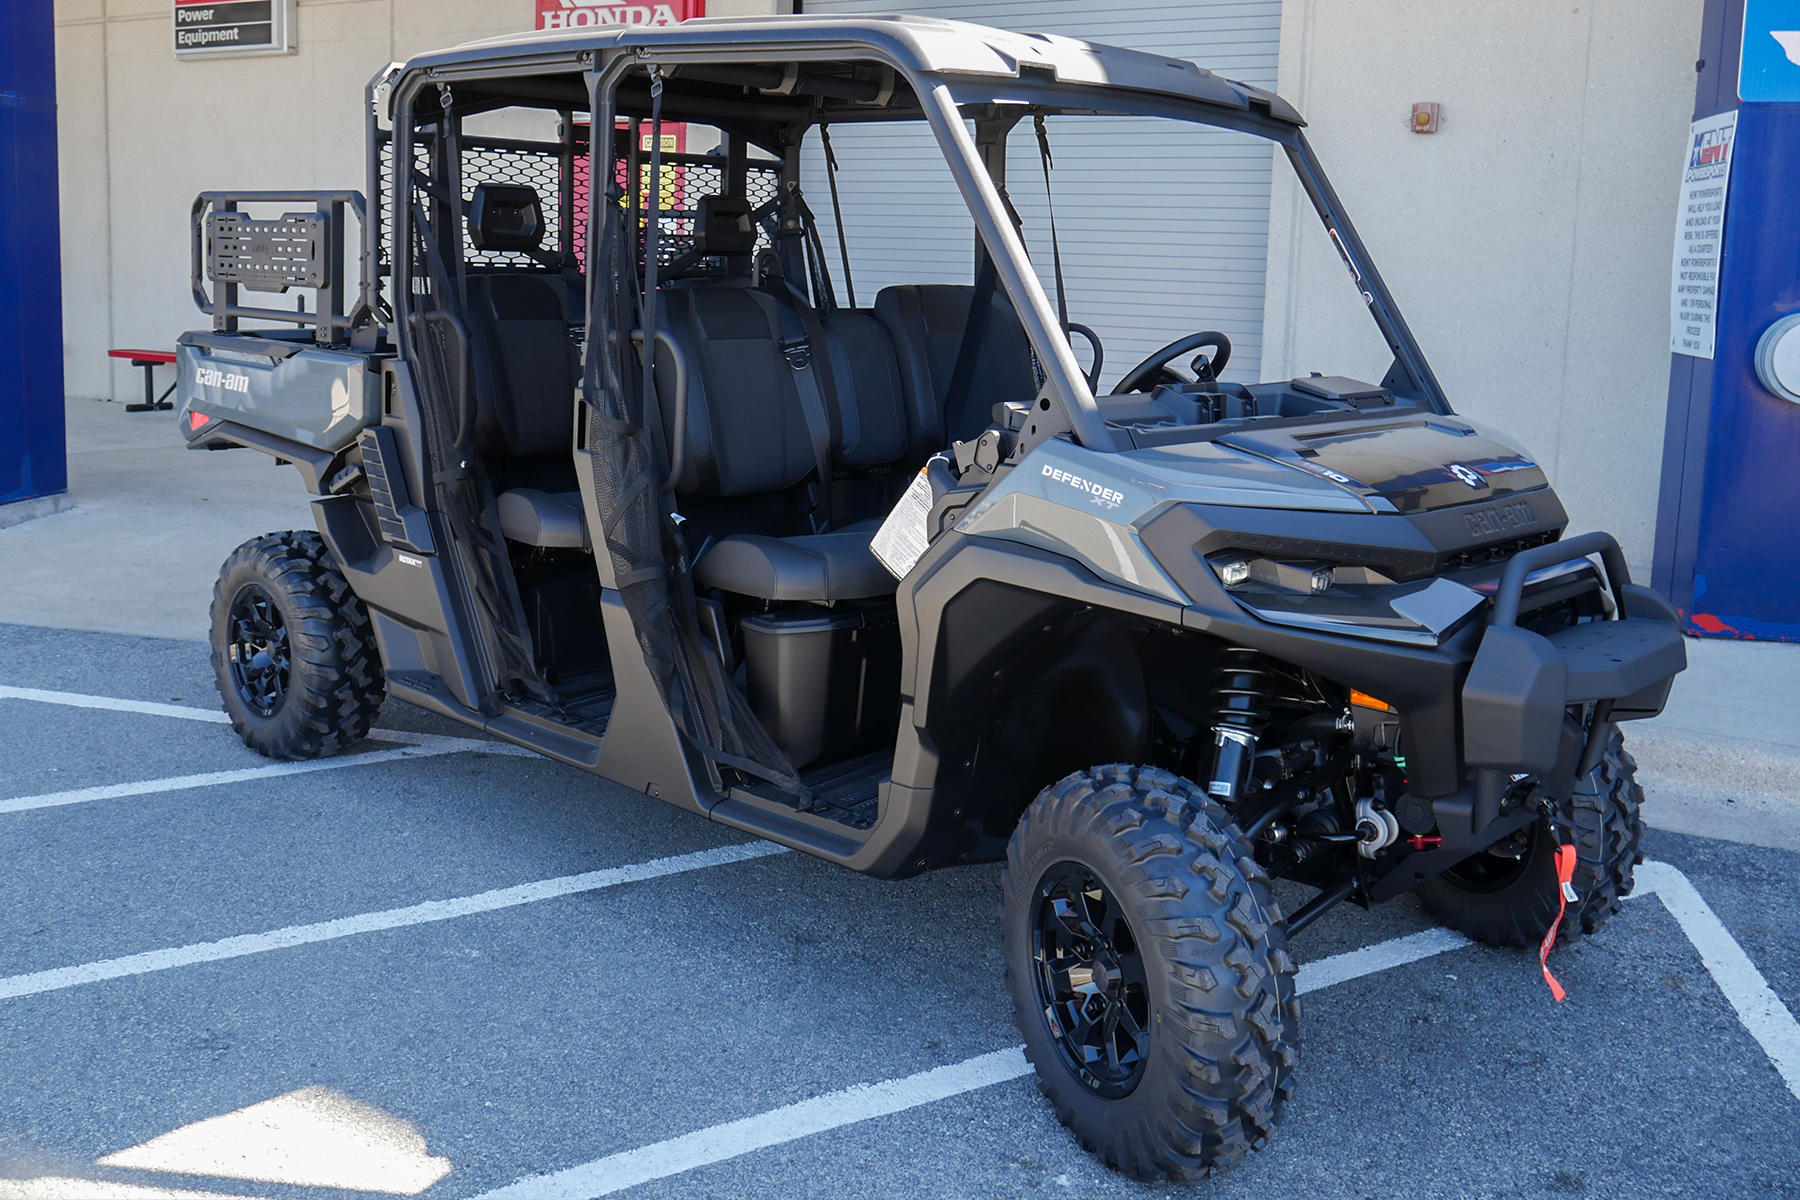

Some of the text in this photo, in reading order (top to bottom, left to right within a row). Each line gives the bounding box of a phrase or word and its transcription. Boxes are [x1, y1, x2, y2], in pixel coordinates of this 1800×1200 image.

[177, 9, 214, 22] Power
[541, 4, 681, 30] HONDA
[177, 27, 239, 46] Equipment
[1685, 164, 1726, 182] POWERSPORTS
[195, 367, 249, 393] can-am
[1041, 464, 1124, 504] DEFENDER
[1090, 495, 1119, 510] XT
[1463, 501, 1539, 538] can-am
